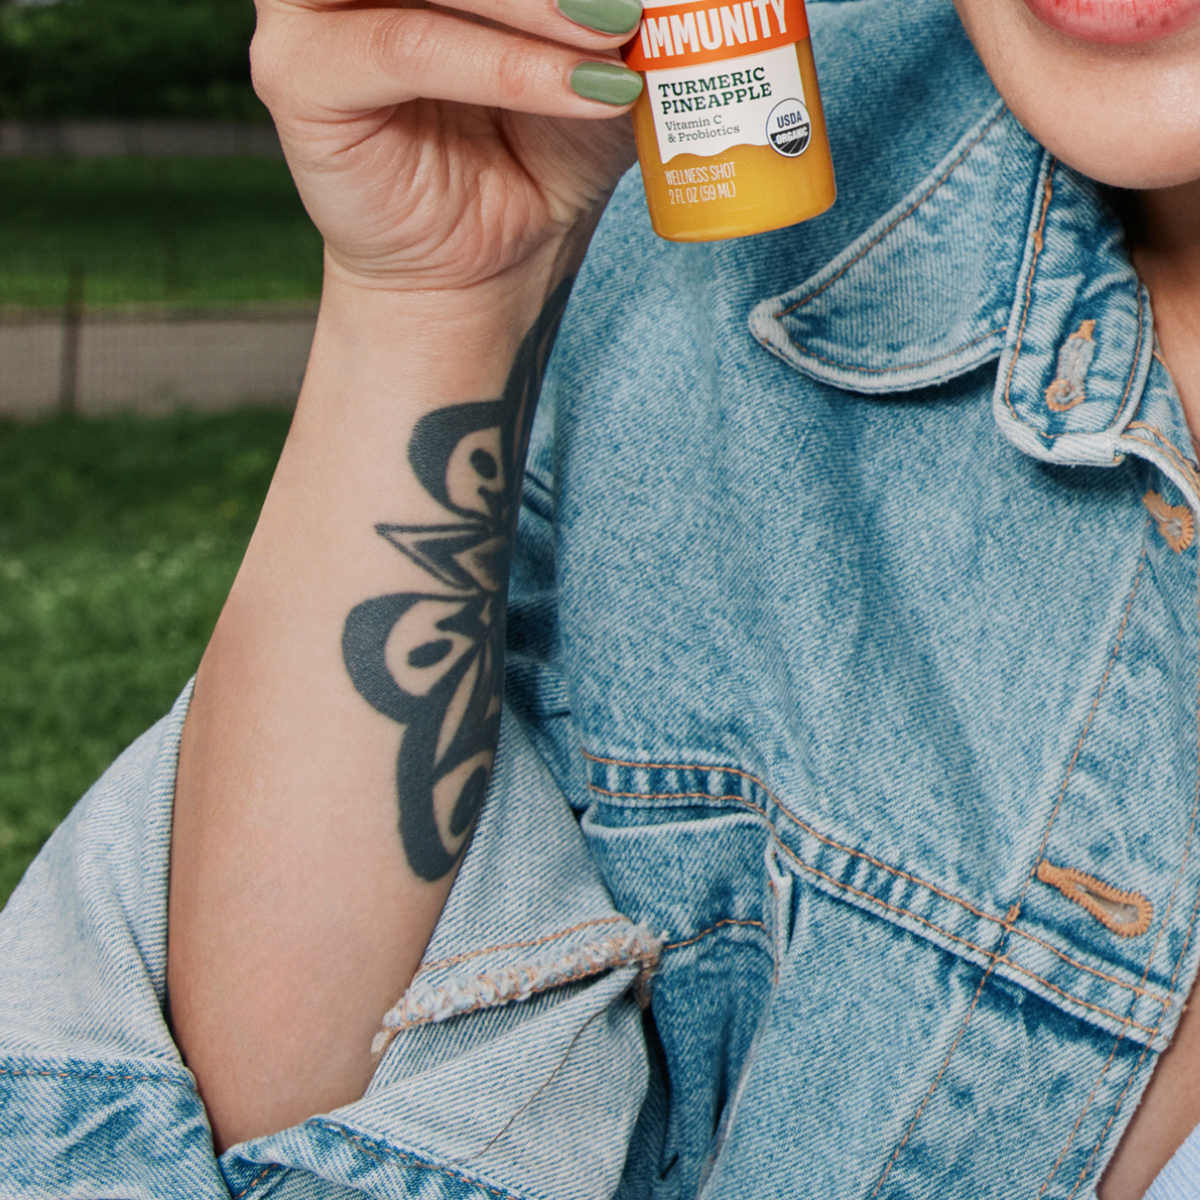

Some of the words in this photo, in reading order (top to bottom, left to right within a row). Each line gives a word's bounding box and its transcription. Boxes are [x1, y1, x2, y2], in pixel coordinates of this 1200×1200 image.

[658, 66, 766, 98] TURMERIC
[661, 82, 772, 115] PINEAPPLE
[664, 117, 711, 132] Vitamin
[713, 114, 722, 125] C
[776, 110, 803, 129] USDA
[667, 133, 676, 143] &
[678, 125, 740, 142] Probiotics
[775, 126, 809, 145] ORGANIC
[664, 167, 709, 186] WELLNESS
[709, 161, 736, 182] SHOT
[668, 189, 676, 205] 2
[675, 188, 686, 204] FL
[686, 186, 699, 203] OZ
[700, 184, 716, 202] (59
[717, 180, 736, 199] ML)
